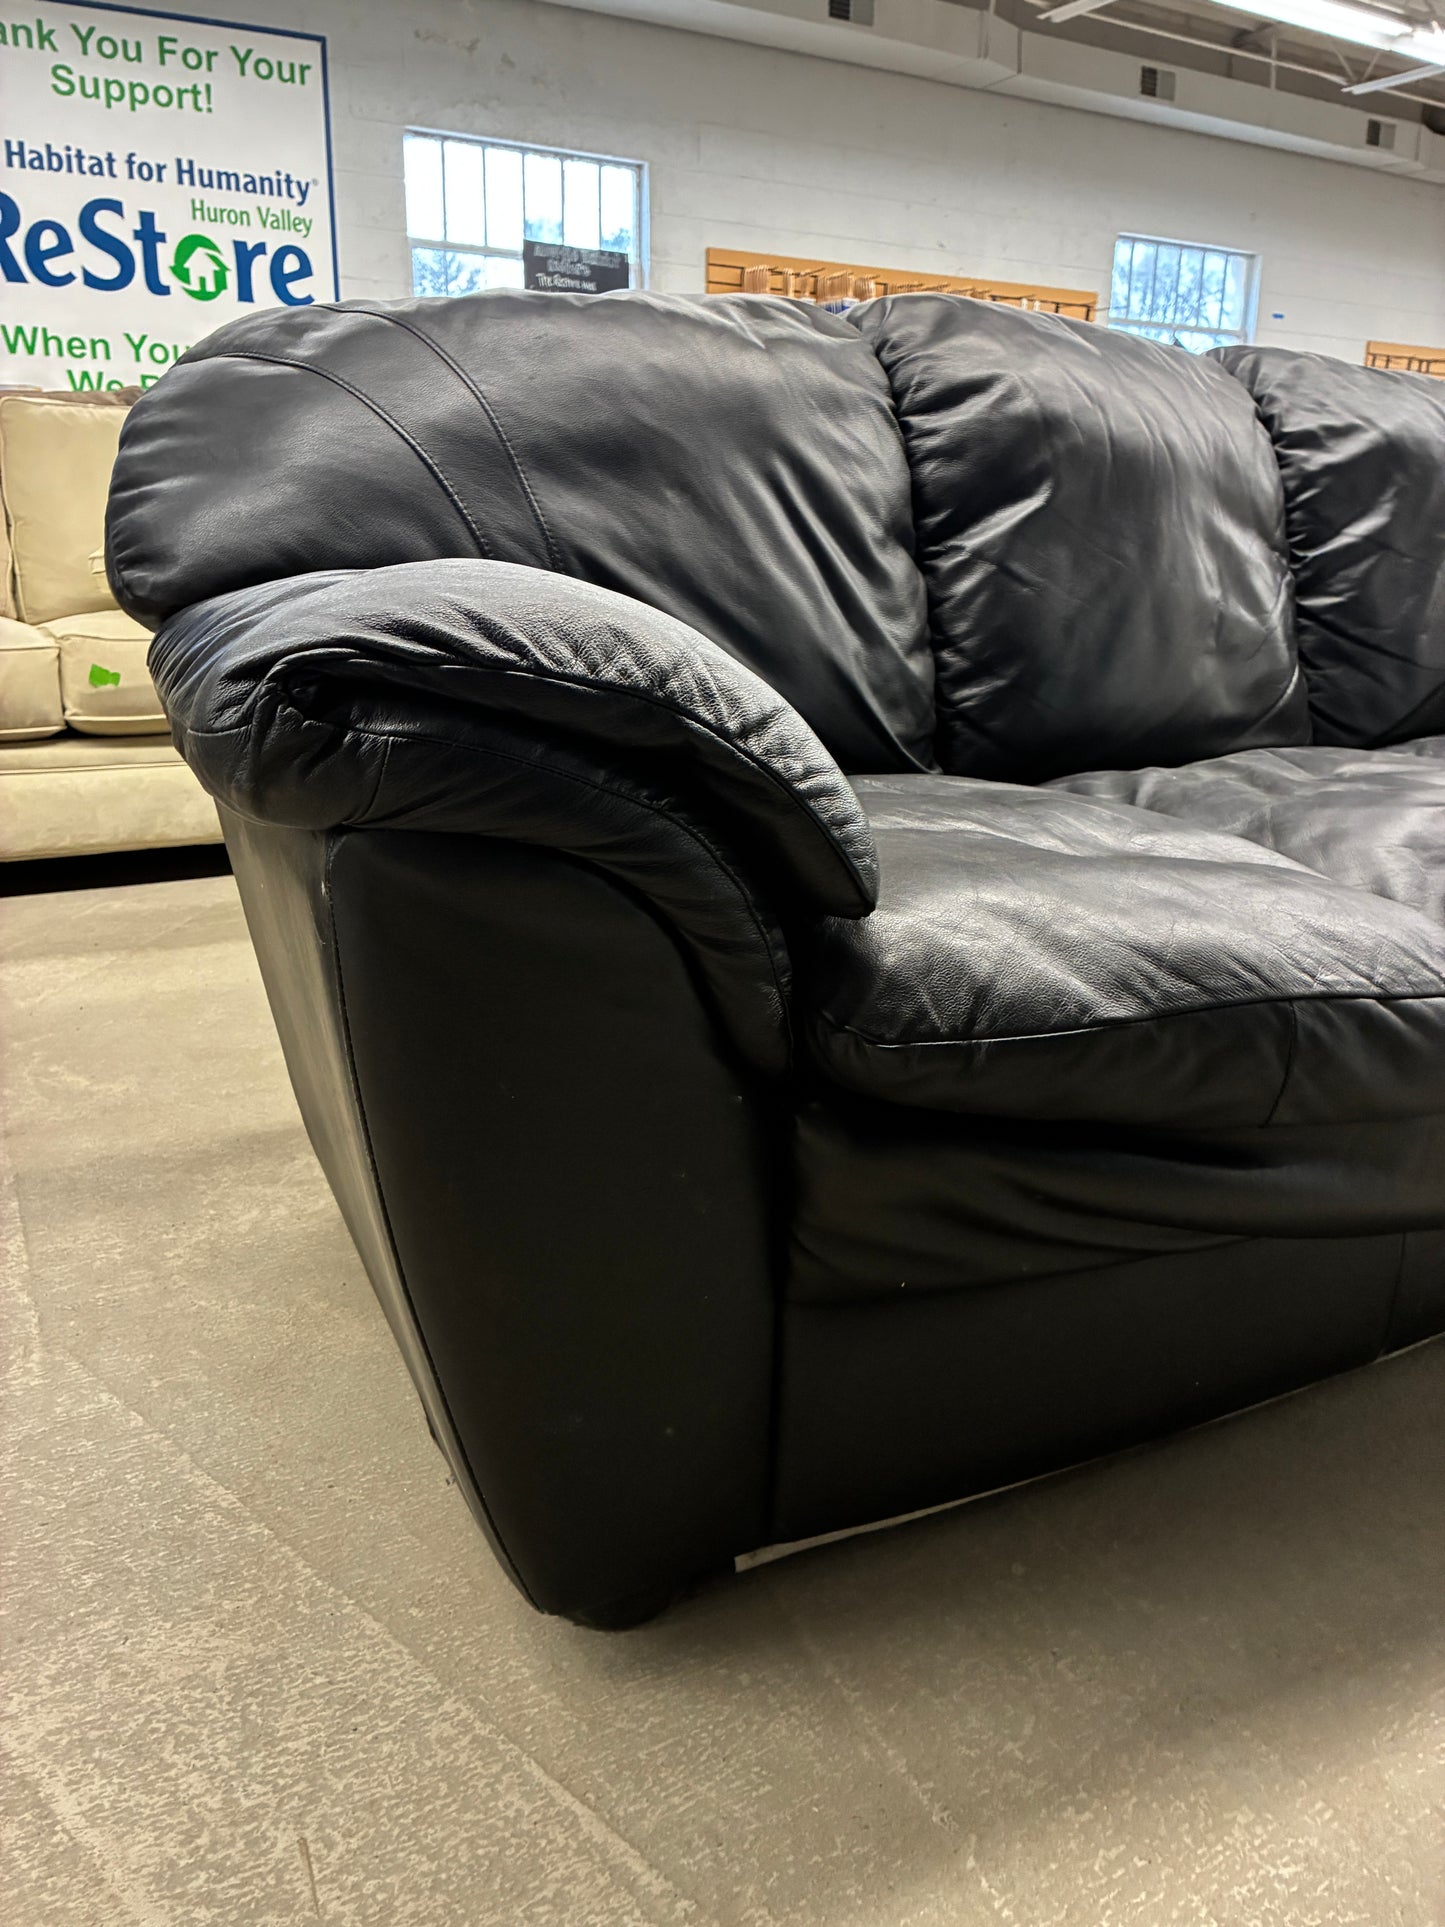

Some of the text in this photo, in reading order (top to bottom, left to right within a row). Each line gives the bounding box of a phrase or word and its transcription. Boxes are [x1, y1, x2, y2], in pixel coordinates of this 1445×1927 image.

[70, 23, 142, 63] You
[158, 36, 218, 72] For
[230, 46, 312, 85] Your
[50, 64, 213, 113] Support!
[4, 140, 310, 206] Habitat for Humanity
[191, 199, 313, 238] Huron Valley
[0, 324, 111, 360] When
